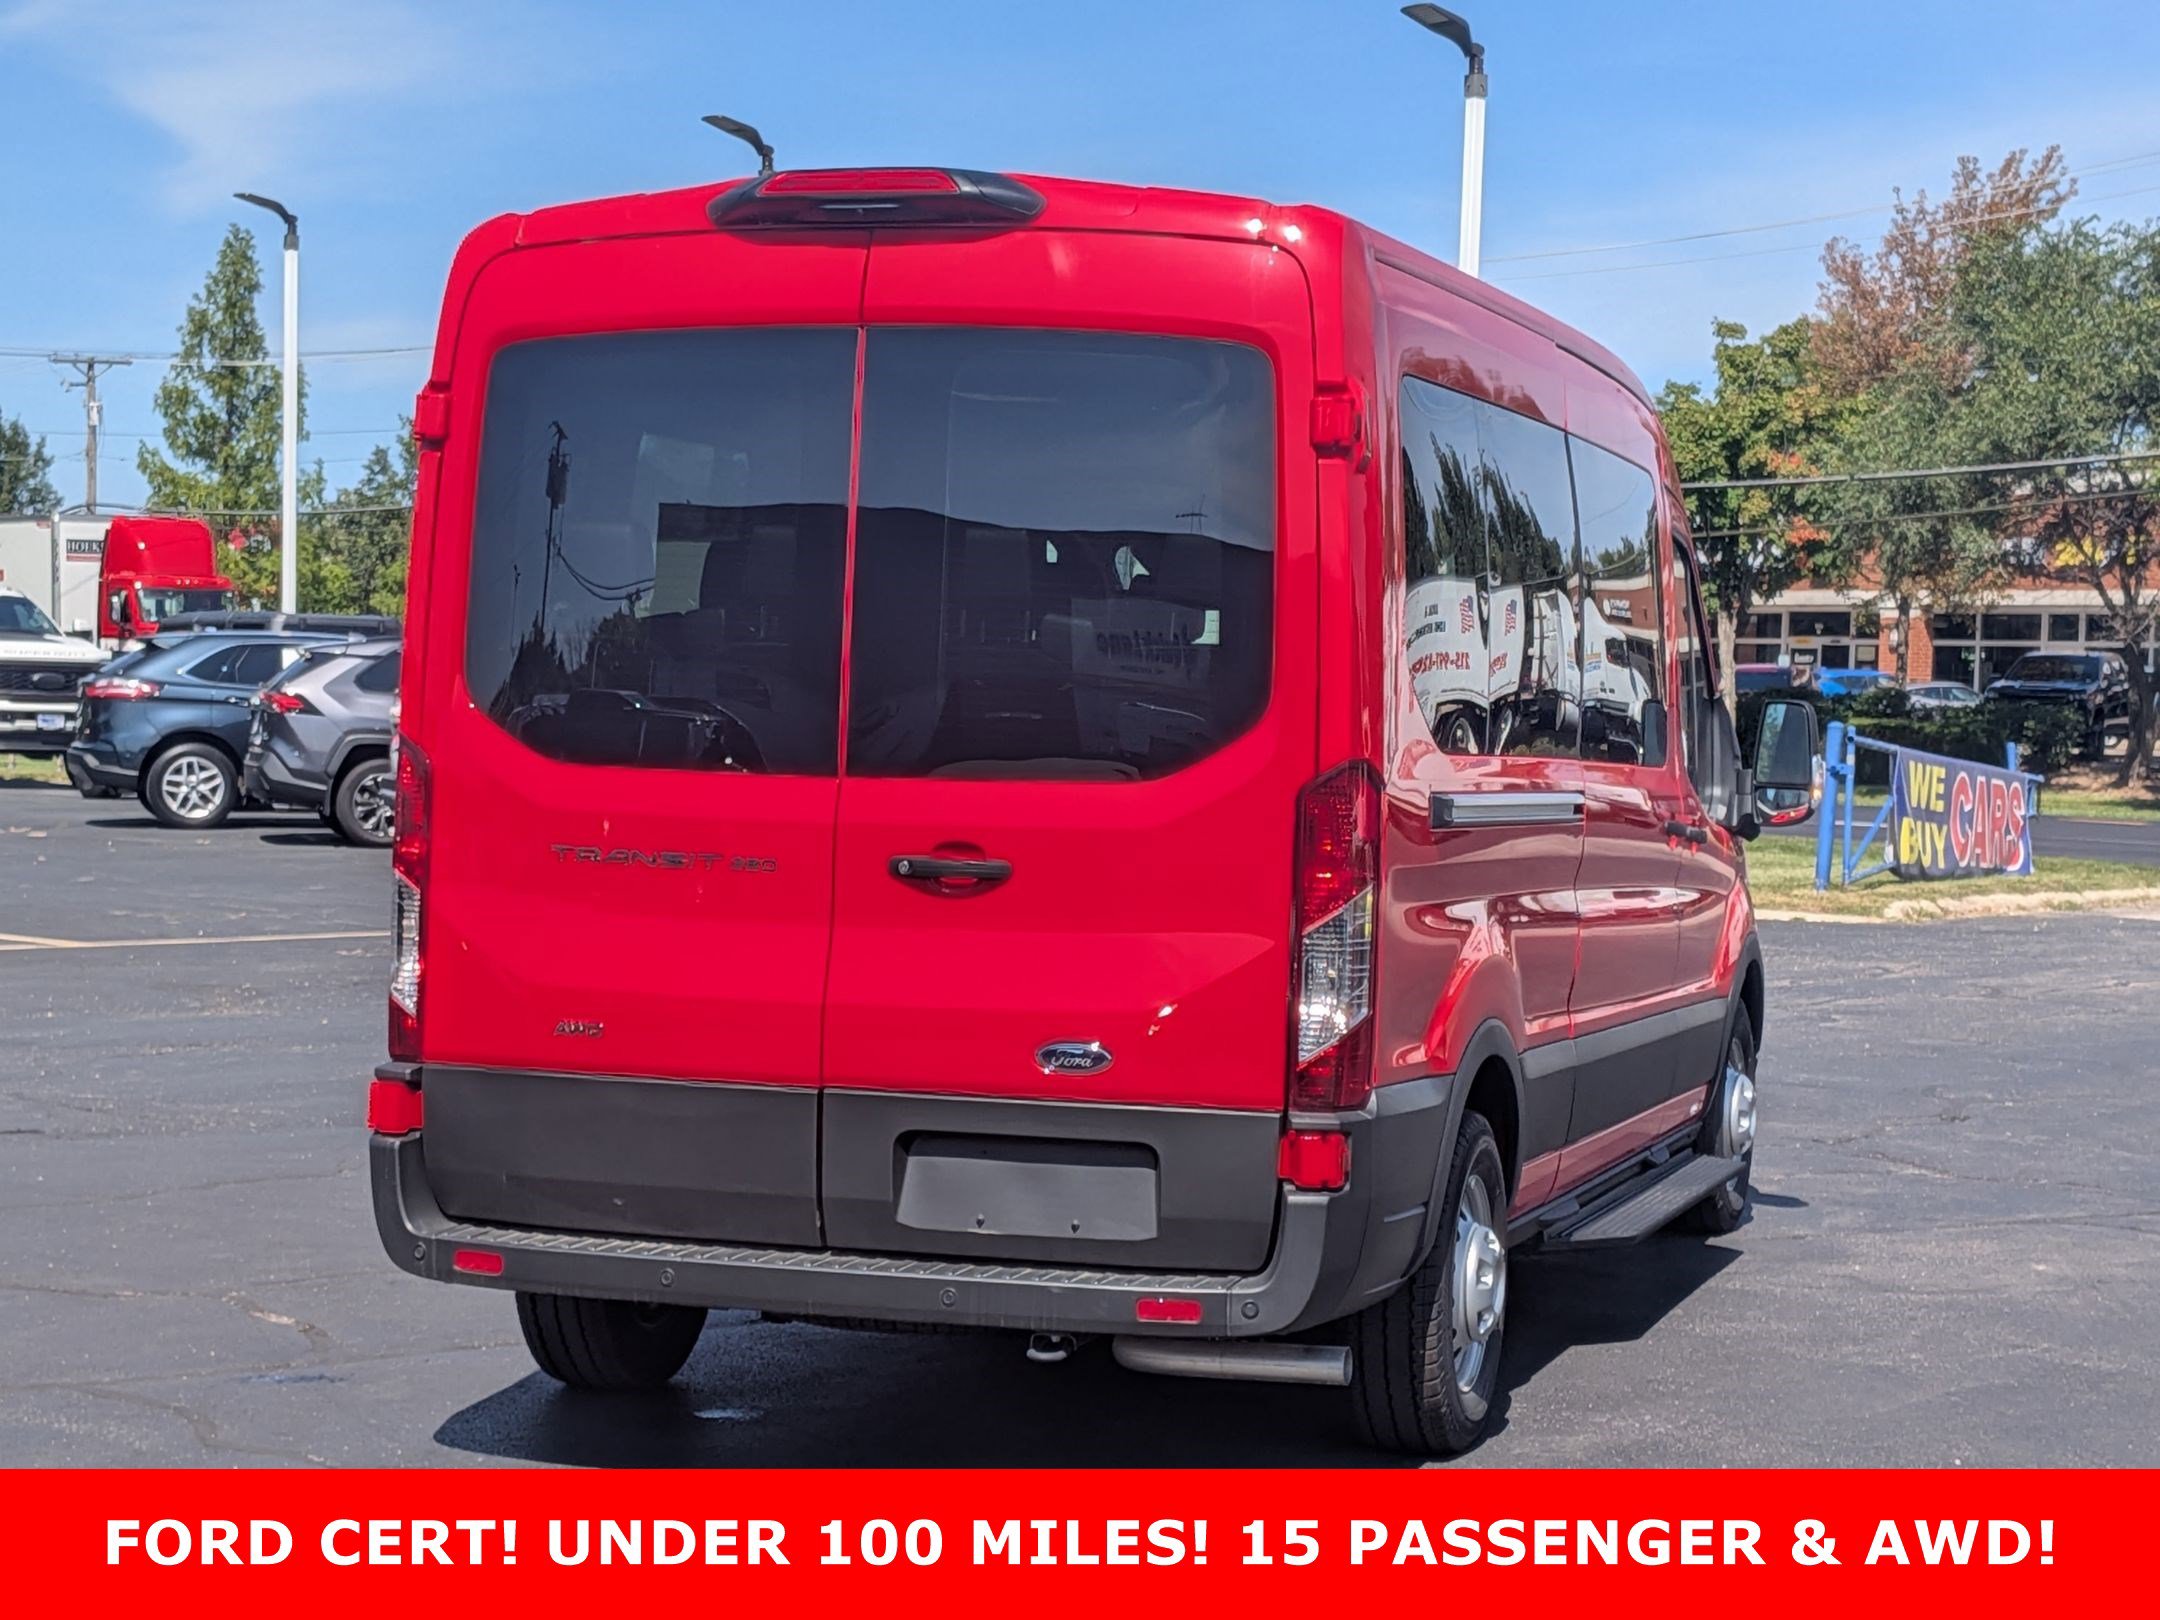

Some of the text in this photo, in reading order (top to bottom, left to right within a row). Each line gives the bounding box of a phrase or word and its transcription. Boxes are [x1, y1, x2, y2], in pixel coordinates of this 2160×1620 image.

[1908, 760, 1946, 812] WE
[1899, 816, 1948, 869] BUY
[1949, 771, 2026, 871] CARS
[551, 844, 723, 869] TRANSIT
